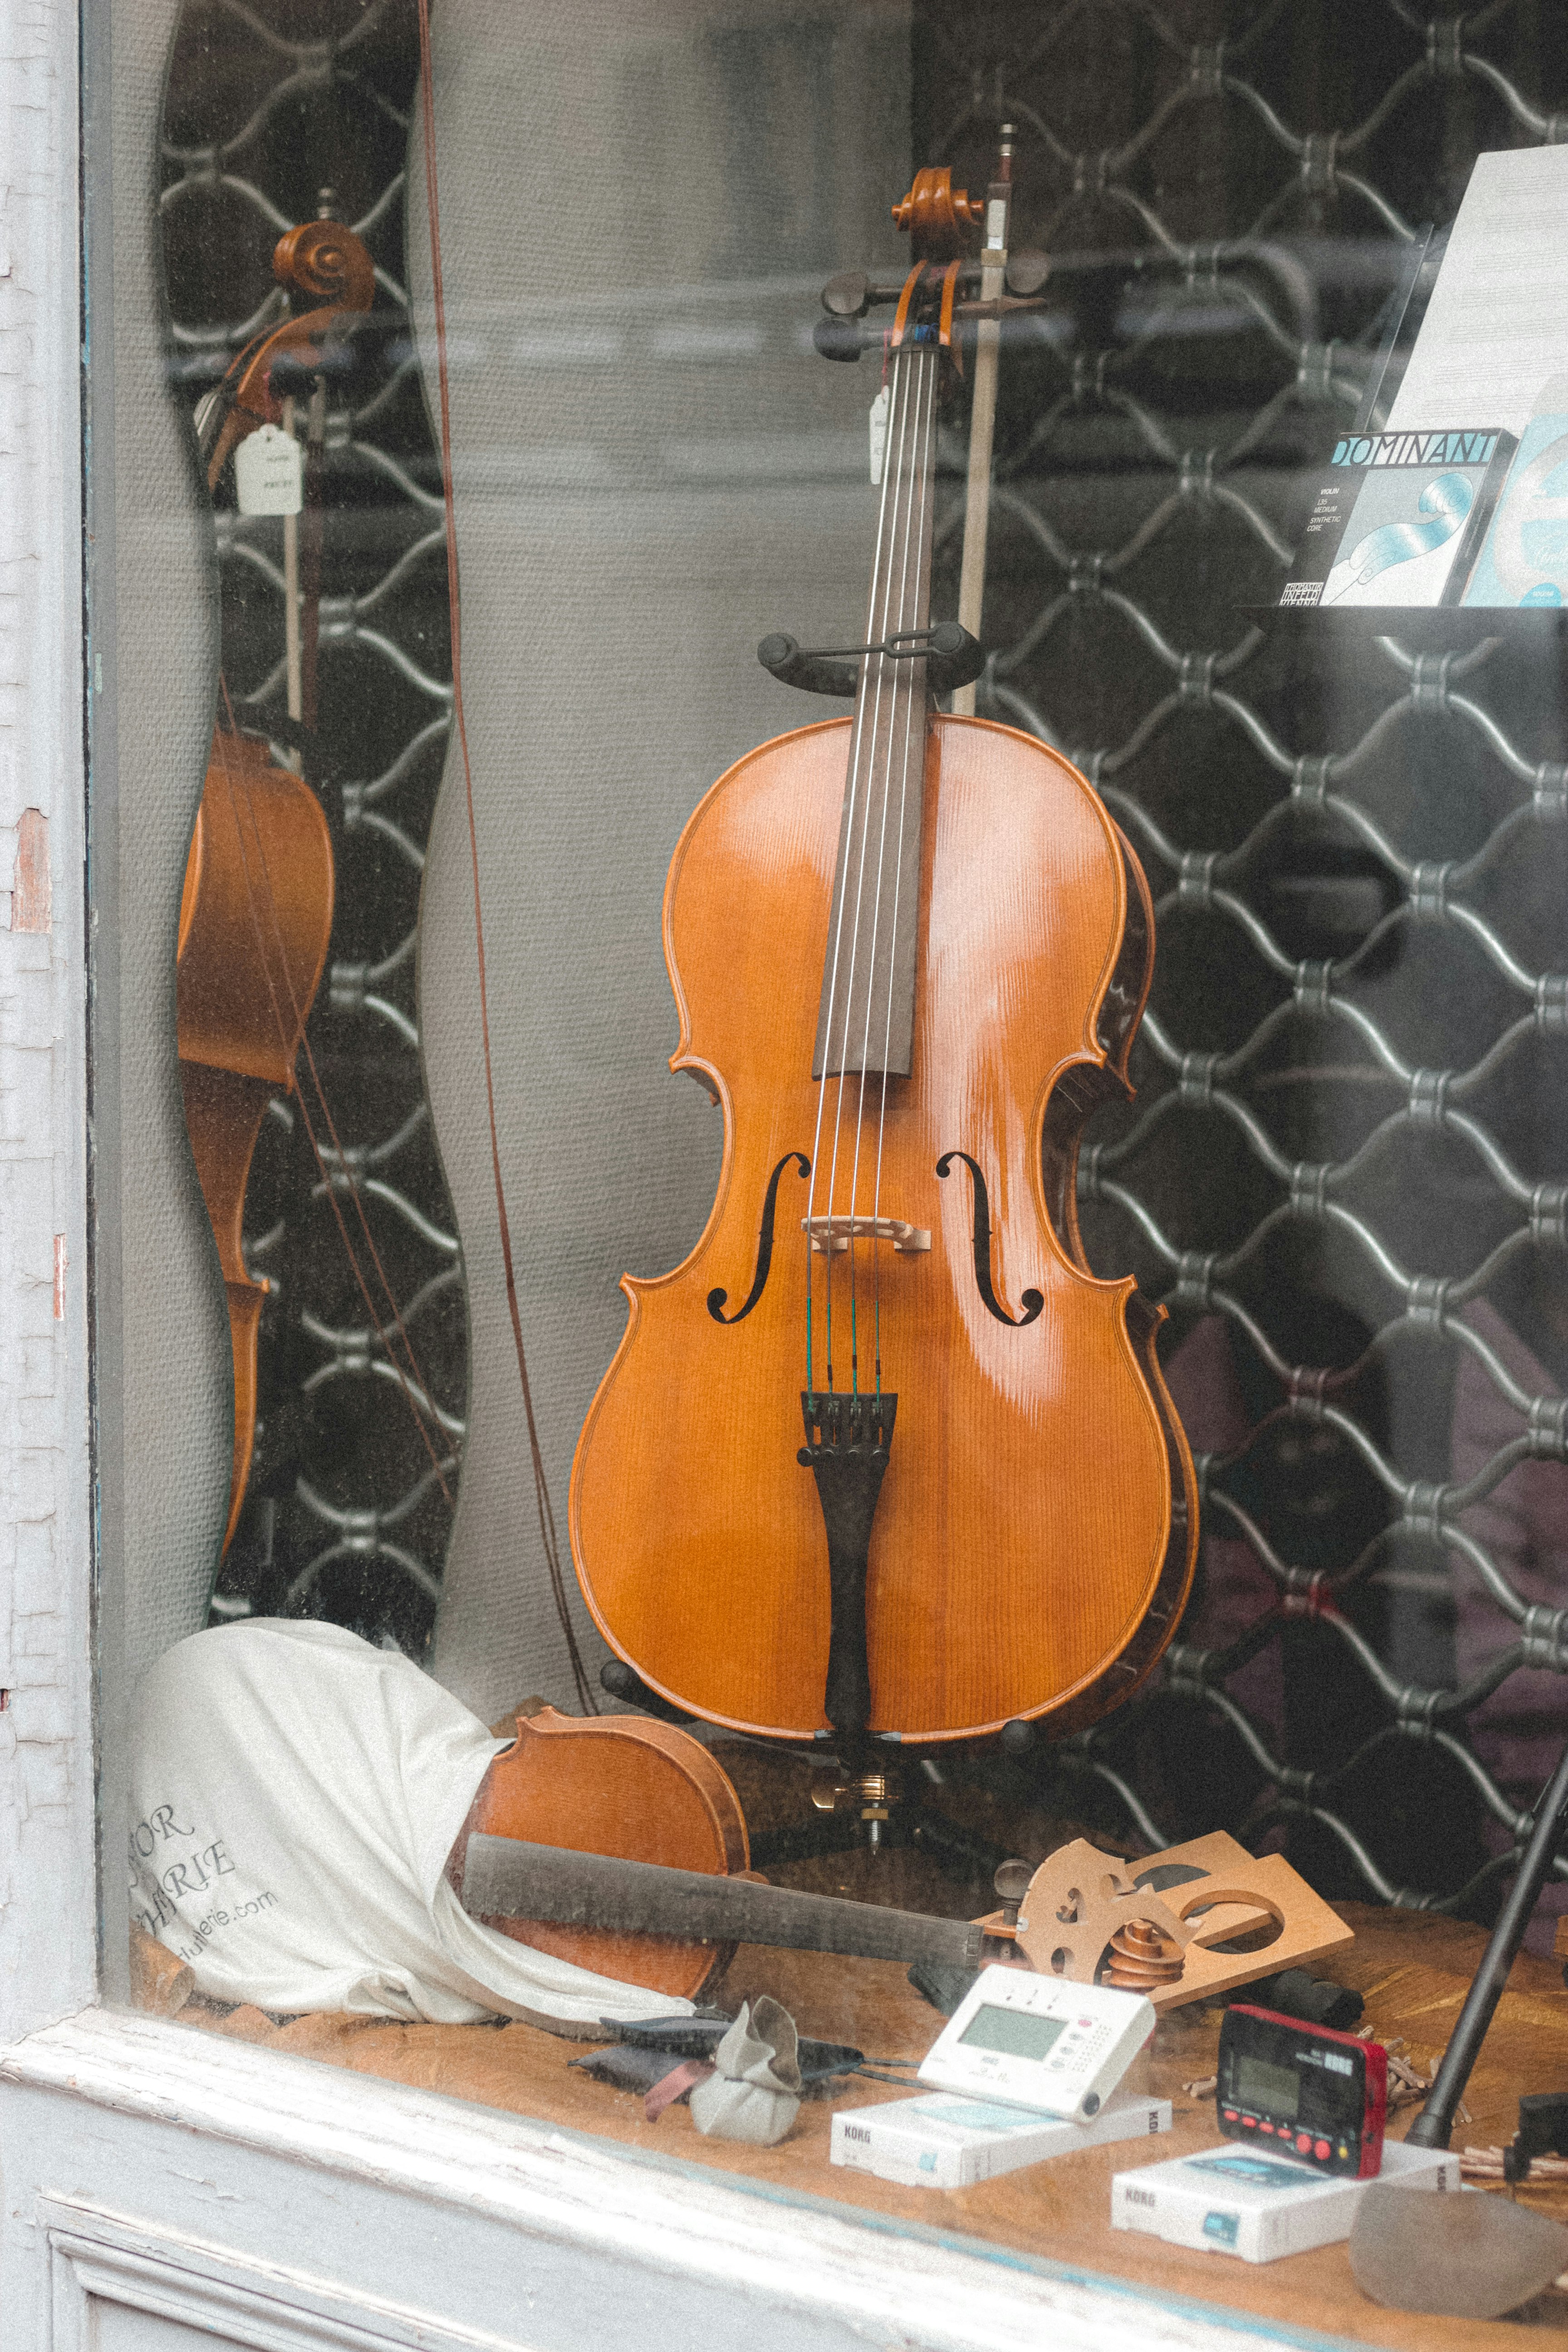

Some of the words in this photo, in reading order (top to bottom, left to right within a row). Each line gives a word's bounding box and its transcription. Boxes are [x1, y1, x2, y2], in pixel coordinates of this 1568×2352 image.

[1331, 432, 1497, 466] DOMINANT
[1309, 515, 1342, 524] SYNTHETIC
[1284, 583, 1323, 591] THOMASTIK
[1281, 590, 1320, 600] INFELD
[844, 2124, 871, 2144] KORG
[1125, 2188, 1156, 2207] KORG
